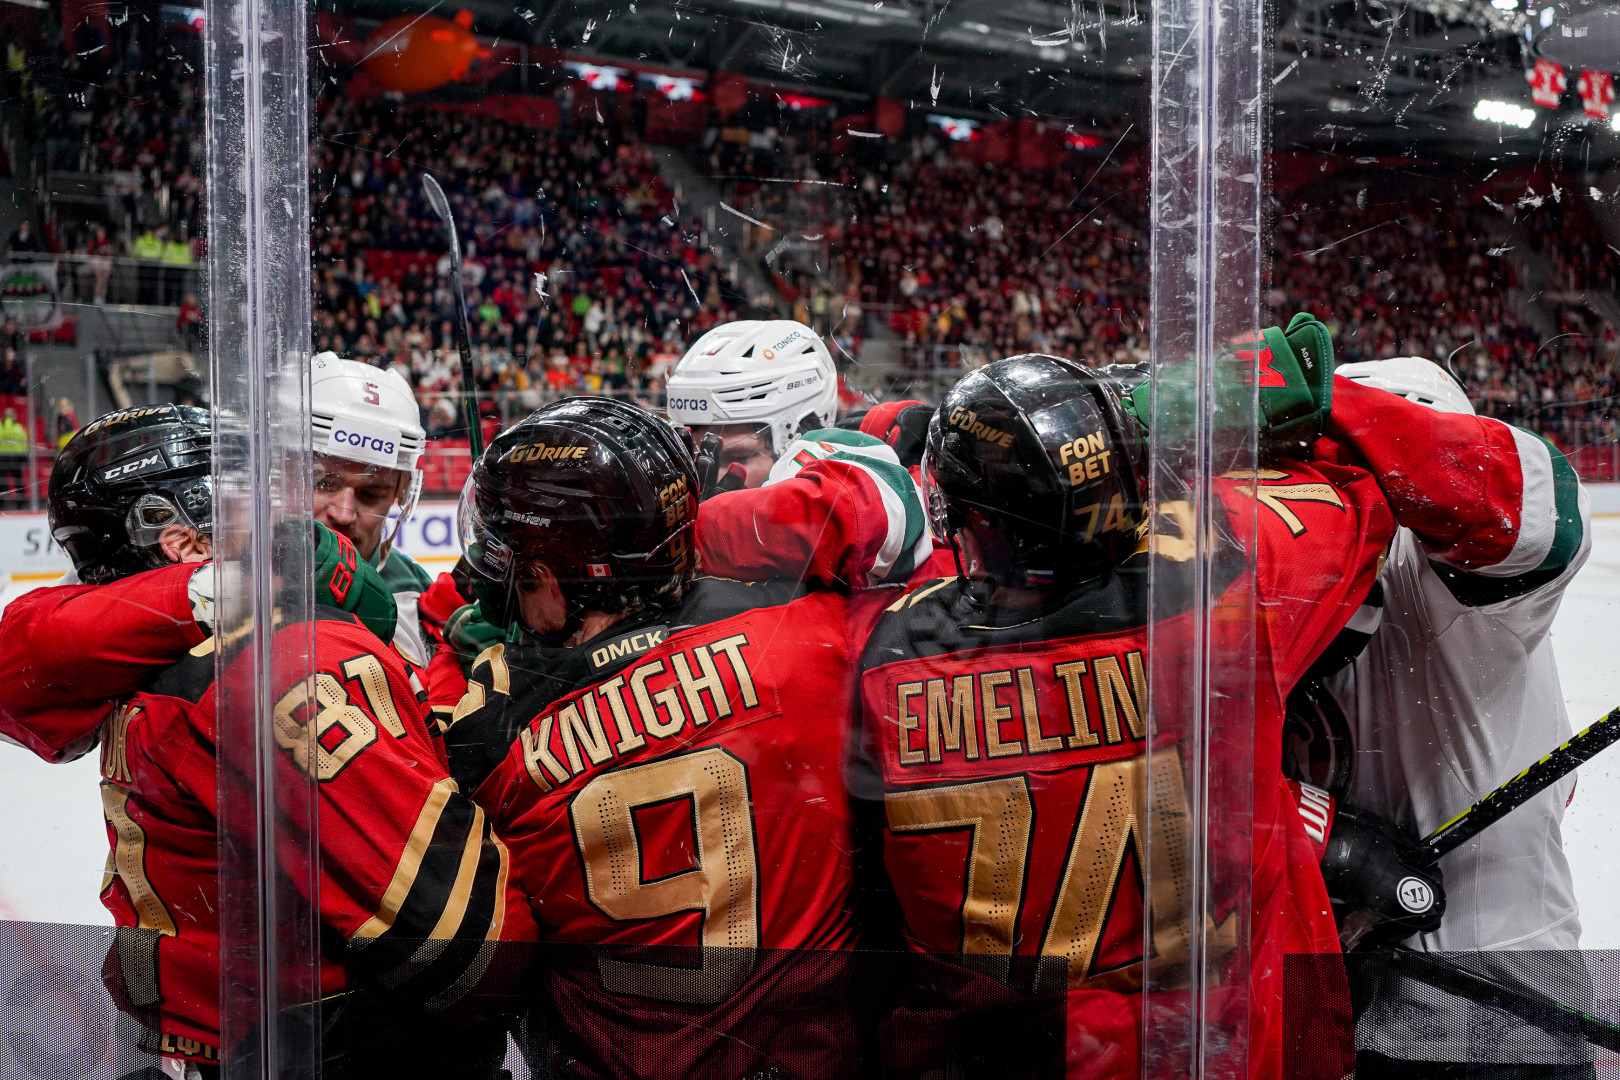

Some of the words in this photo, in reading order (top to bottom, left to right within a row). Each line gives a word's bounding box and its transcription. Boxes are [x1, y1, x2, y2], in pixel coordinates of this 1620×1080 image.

[1300, 347, 1314, 370] ADAM
[363, 382, 380, 406] 5
[1059, 431, 1106, 466] FON
[104, 455, 158, 480] CCM
[1068, 451, 1111, 487] BET
[659, 474, 688, 510] FON
[273, 653, 408, 784] 81
[519, 632, 761, 793] KNIGHT
[896, 650, 1158, 766] EMELIN
[566, 743, 762, 1006] 9
[884, 743, 1238, 990] 74
